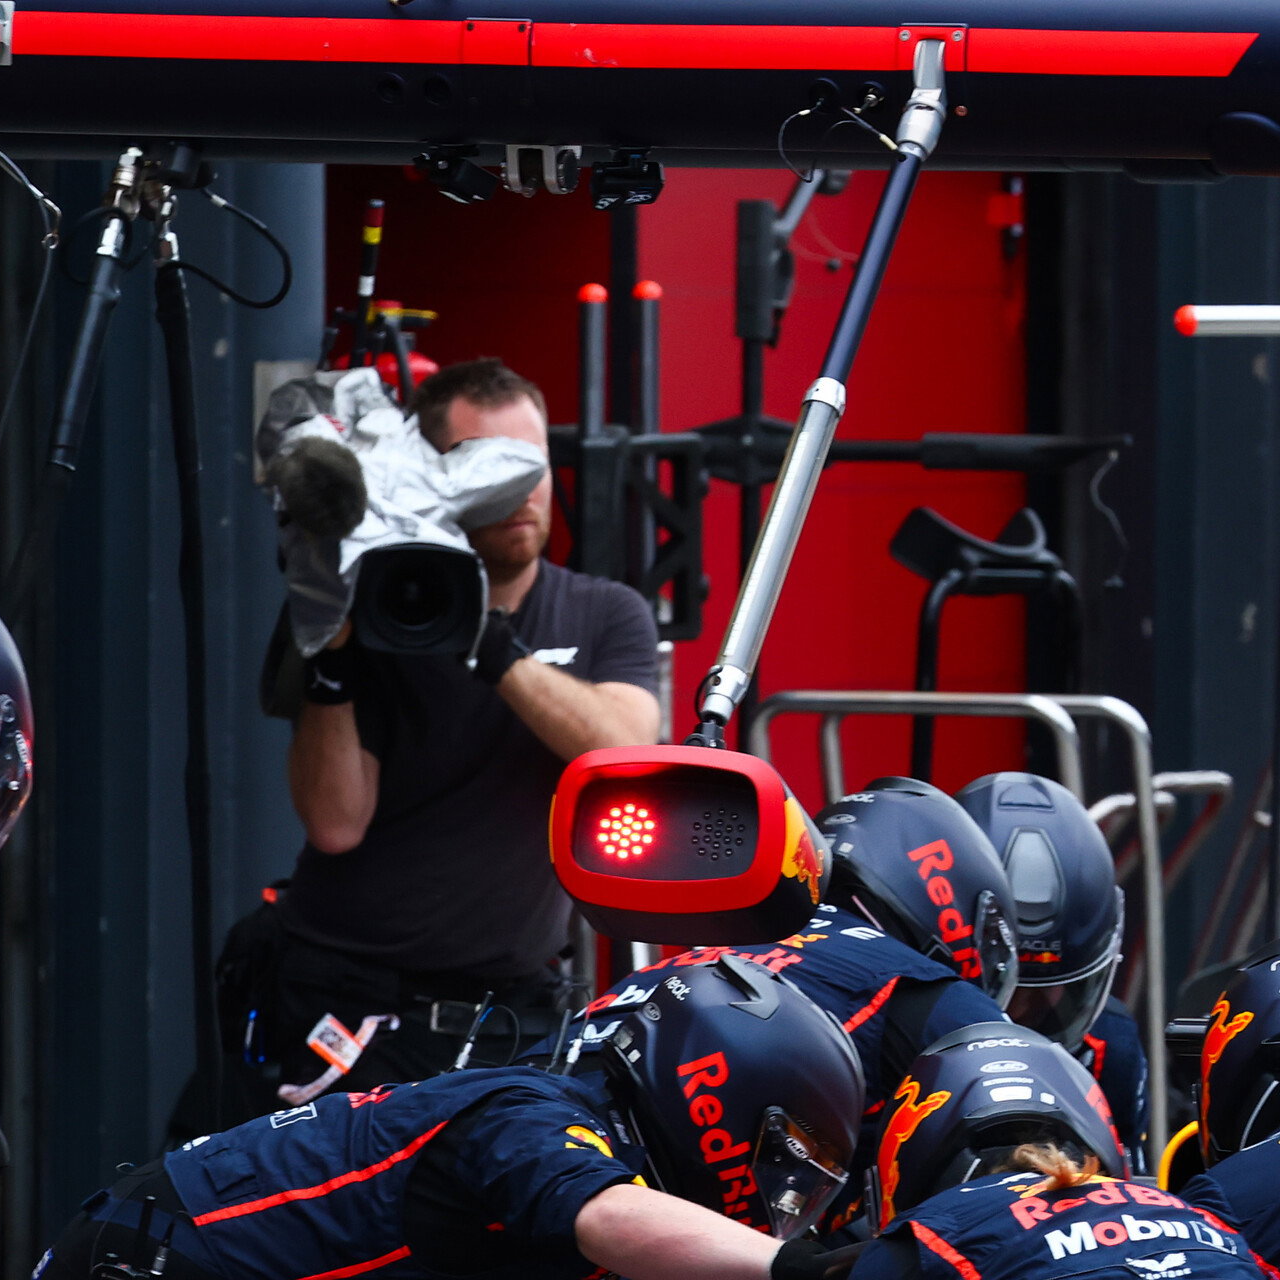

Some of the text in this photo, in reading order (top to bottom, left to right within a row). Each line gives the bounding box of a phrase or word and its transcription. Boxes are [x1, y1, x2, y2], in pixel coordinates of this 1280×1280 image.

[907, 839, 974, 943] Red
[1016, 940, 1062, 951] ACLE
[677, 1051, 752, 1165] Red
[1043, 1213, 1191, 1260] Mobil
